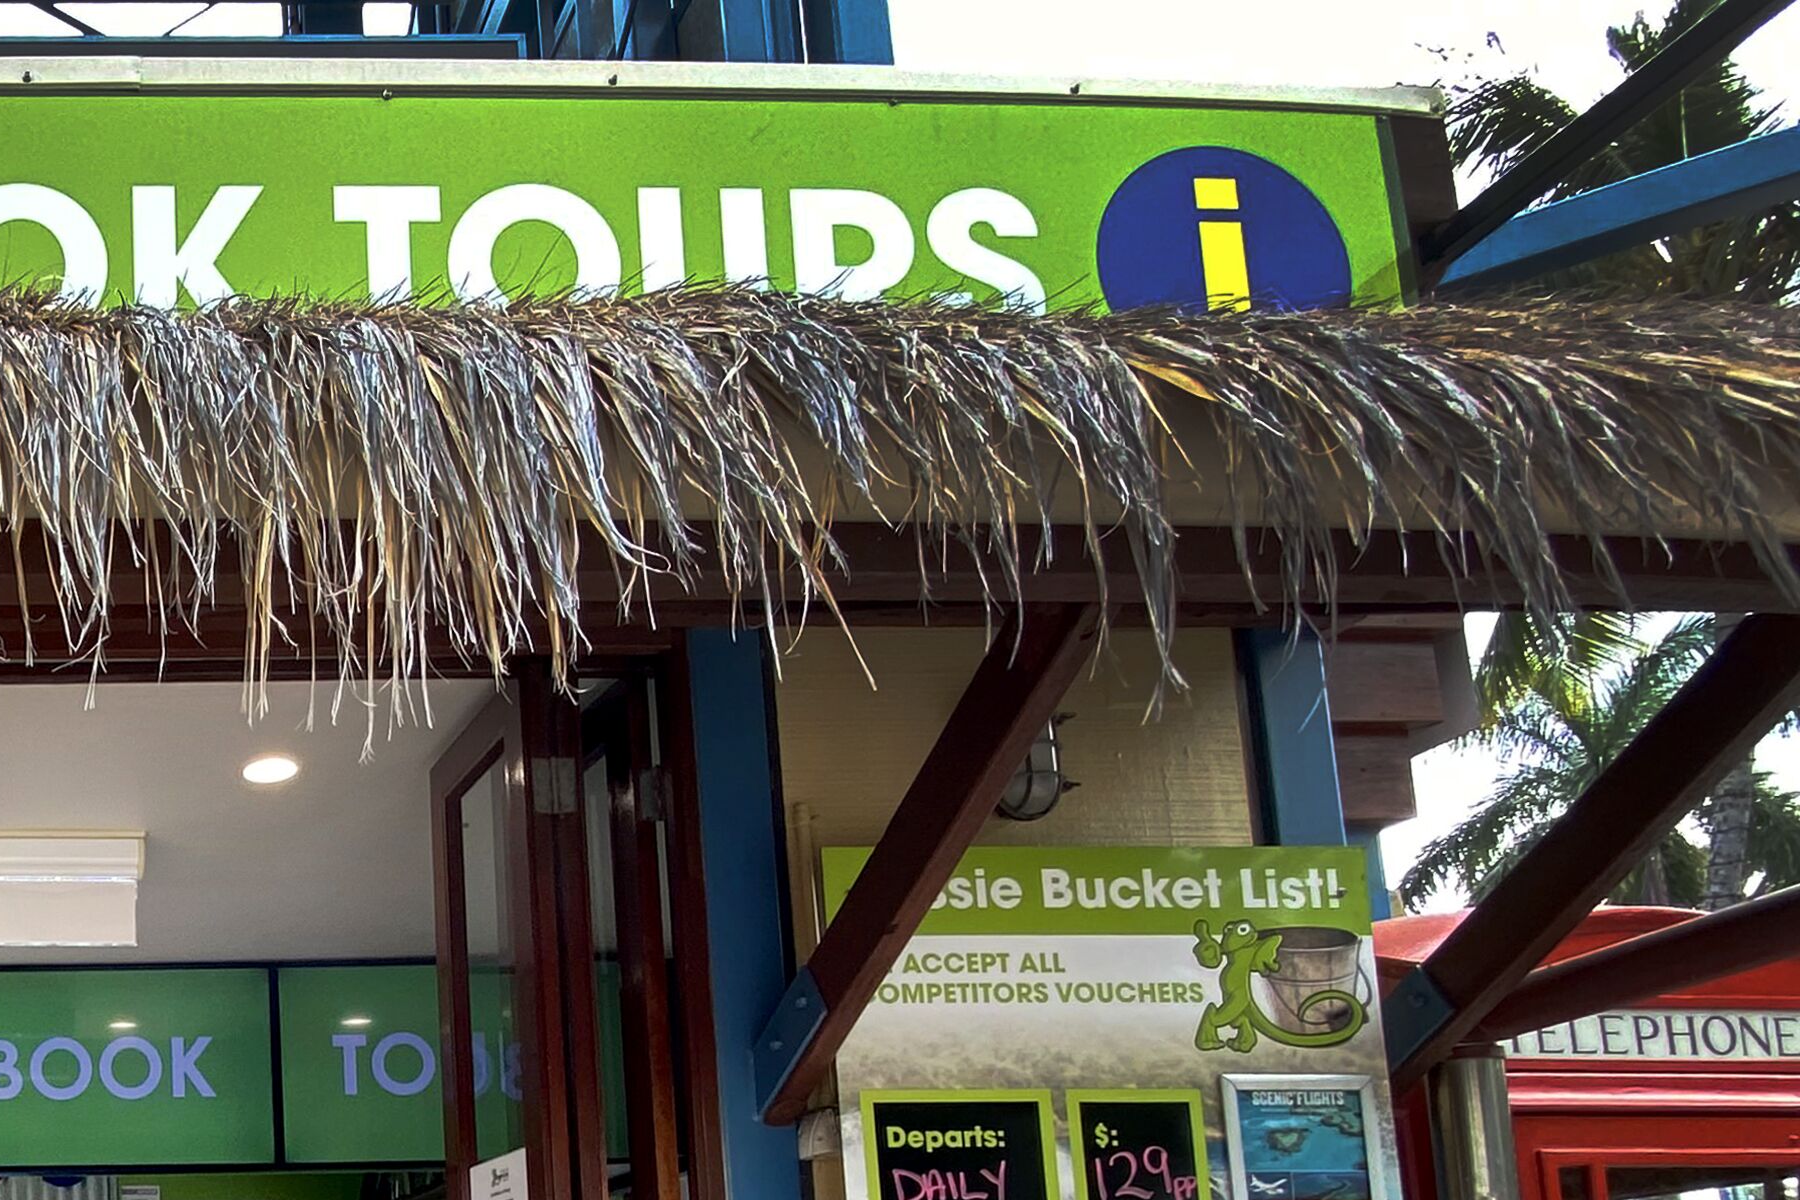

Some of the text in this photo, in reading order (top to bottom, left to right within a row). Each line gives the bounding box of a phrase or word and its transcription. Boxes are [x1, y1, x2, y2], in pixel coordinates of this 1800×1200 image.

[332, 183, 1046, 314] TOURS
[929, 868, 1341, 909] sie Bucket List!
[902, 952, 1010, 974] ACCEPT
[1019, 952, 1066, 974] ALL
[1054, 982, 1204, 1003] VOUCHERS
[1252, 1091, 1345, 1106] SCENIC FLIGHTS
[886, 1126, 1006, 1153] Departs:
